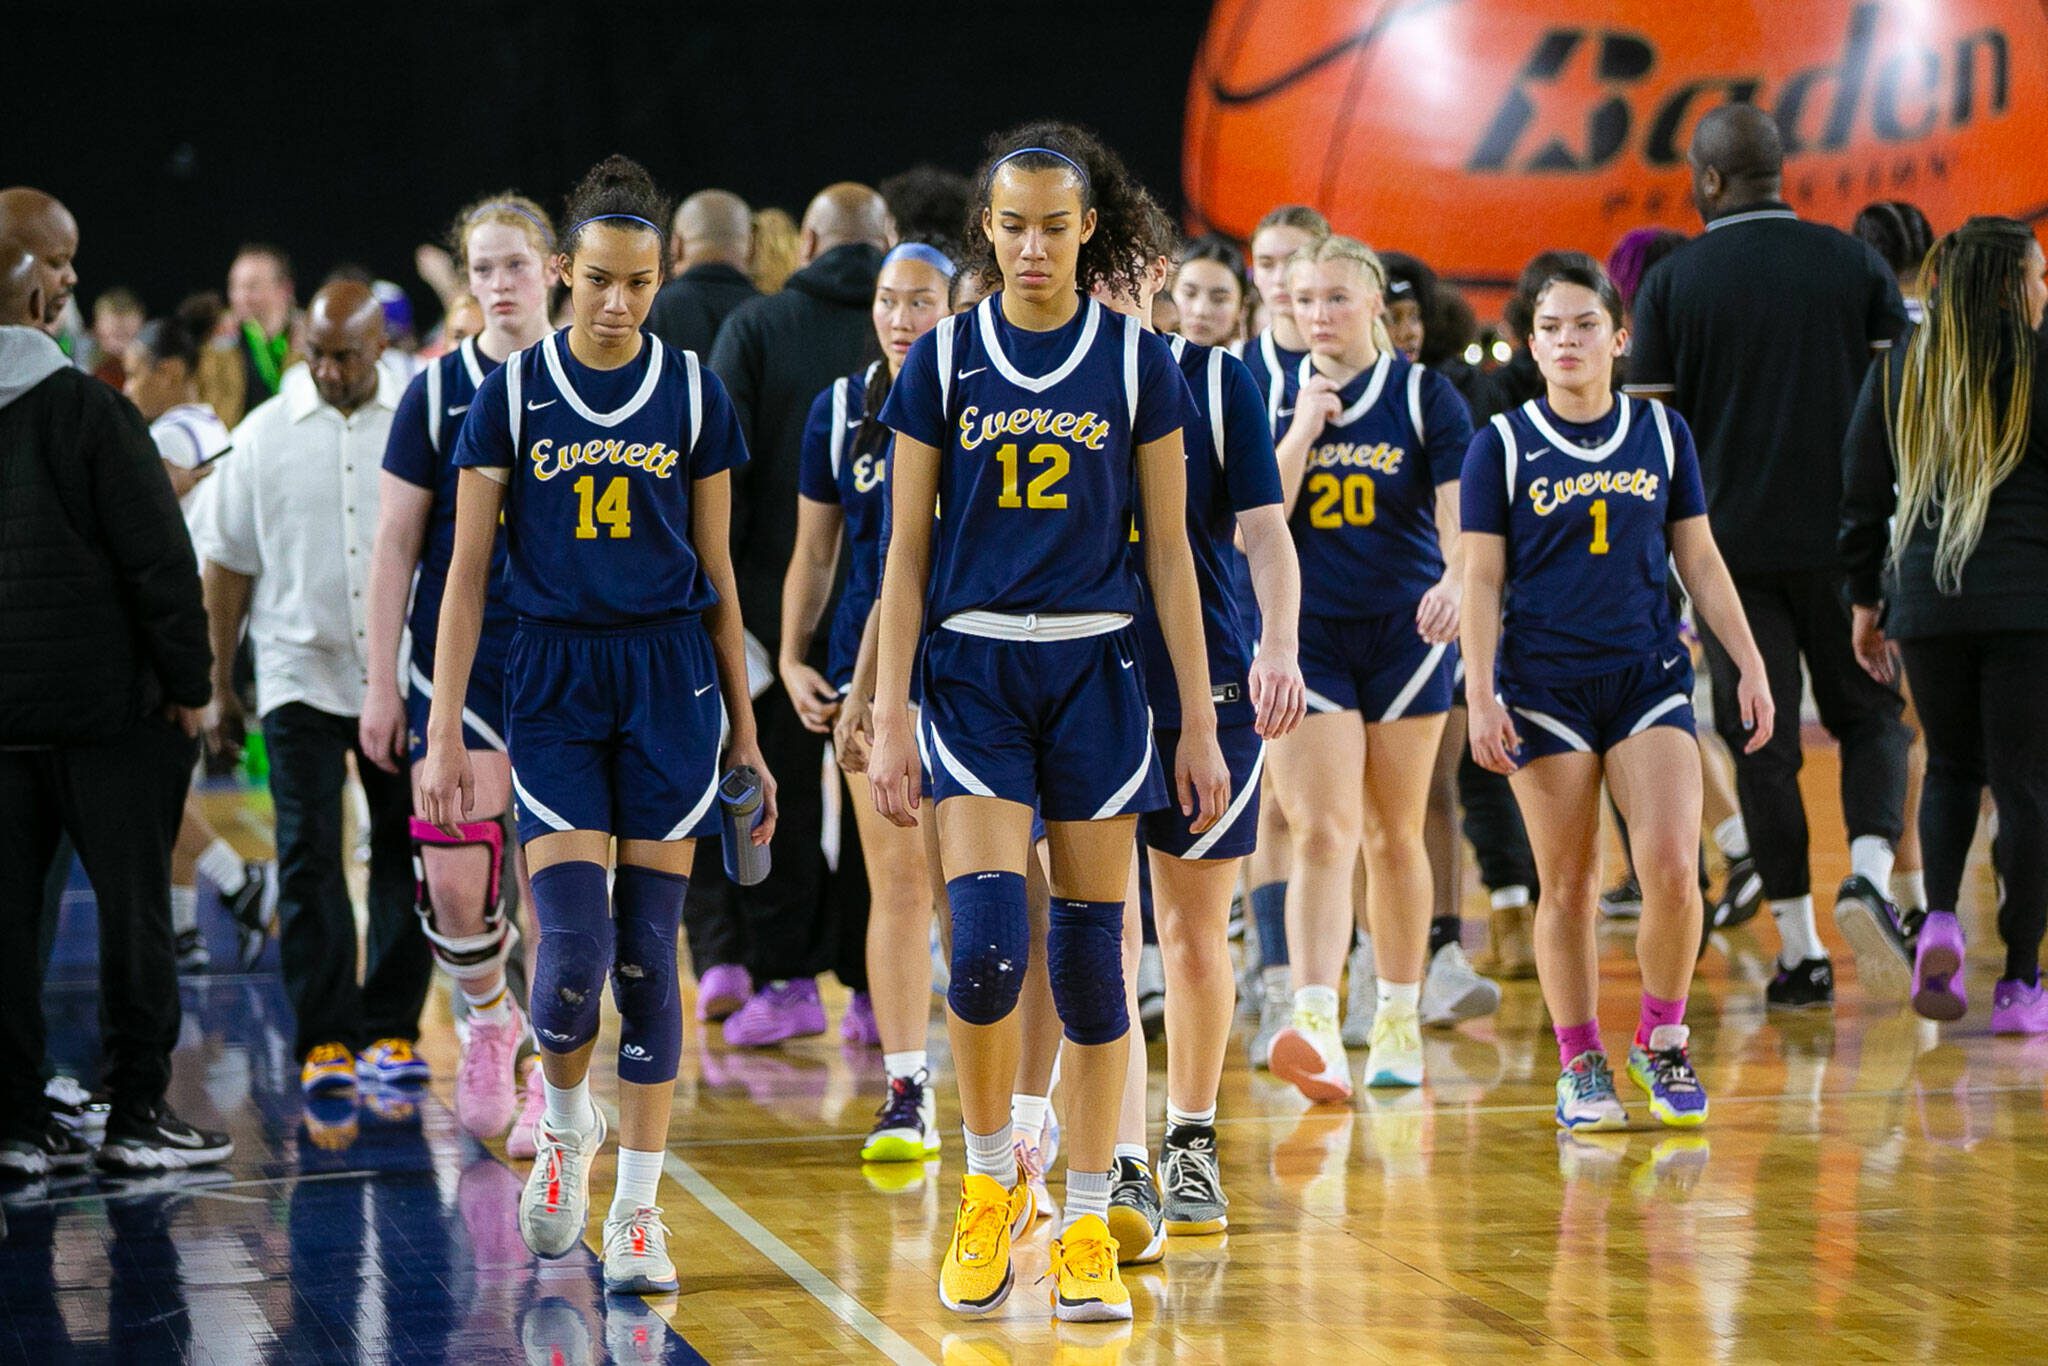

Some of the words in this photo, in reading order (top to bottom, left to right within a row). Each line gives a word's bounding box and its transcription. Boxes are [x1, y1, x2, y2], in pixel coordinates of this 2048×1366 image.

[959, 405, 1110, 451] Everett
[530, 438, 680, 482] Everett
[996, 443, 1071, 509] 12
[1305, 442, 1405, 476] erett
[573, 475, 632, 539] 14
[1308, 472, 1377, 529] 20
[1528, 467, 1660, 517] Everett
[1589, 498, 1610, 555] 1
